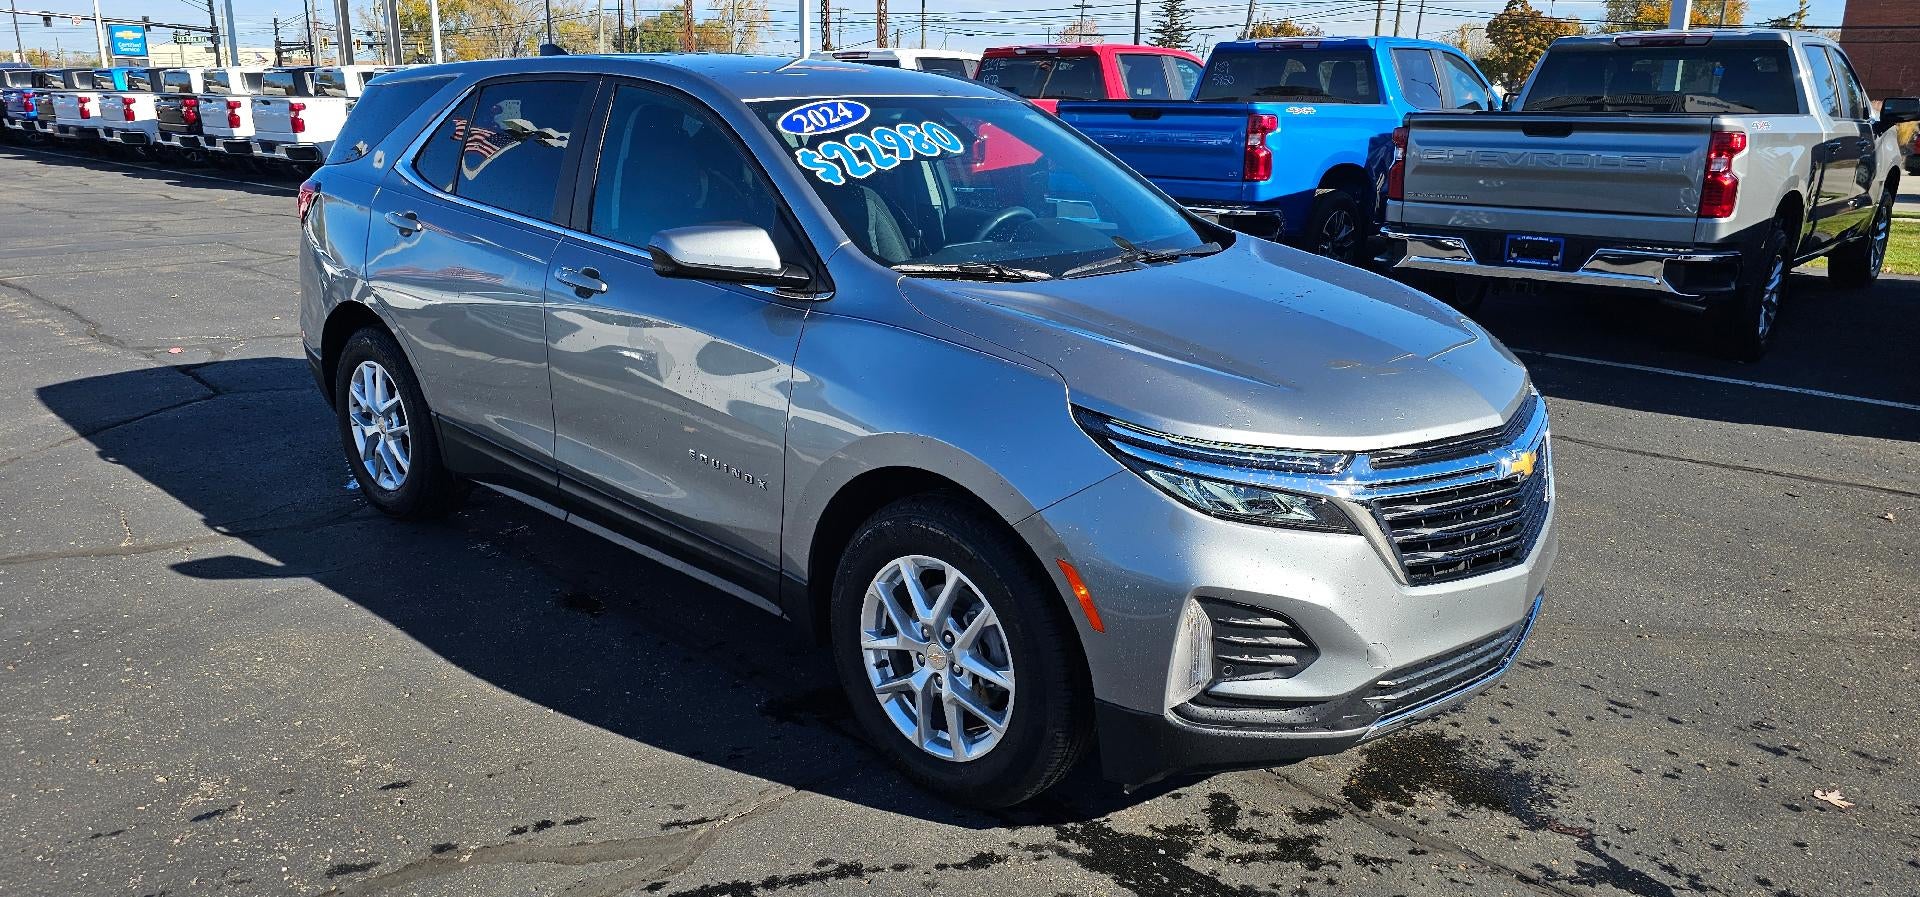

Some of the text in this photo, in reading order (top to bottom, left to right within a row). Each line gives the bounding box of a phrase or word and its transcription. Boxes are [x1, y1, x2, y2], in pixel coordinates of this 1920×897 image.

[793, 103, 853, 133] 2024
[795, 121, 964, 185] $22980
[1419, 148, 1683, 171] CHEVROLET
[688, 448, 768, 490] EQUINOX
